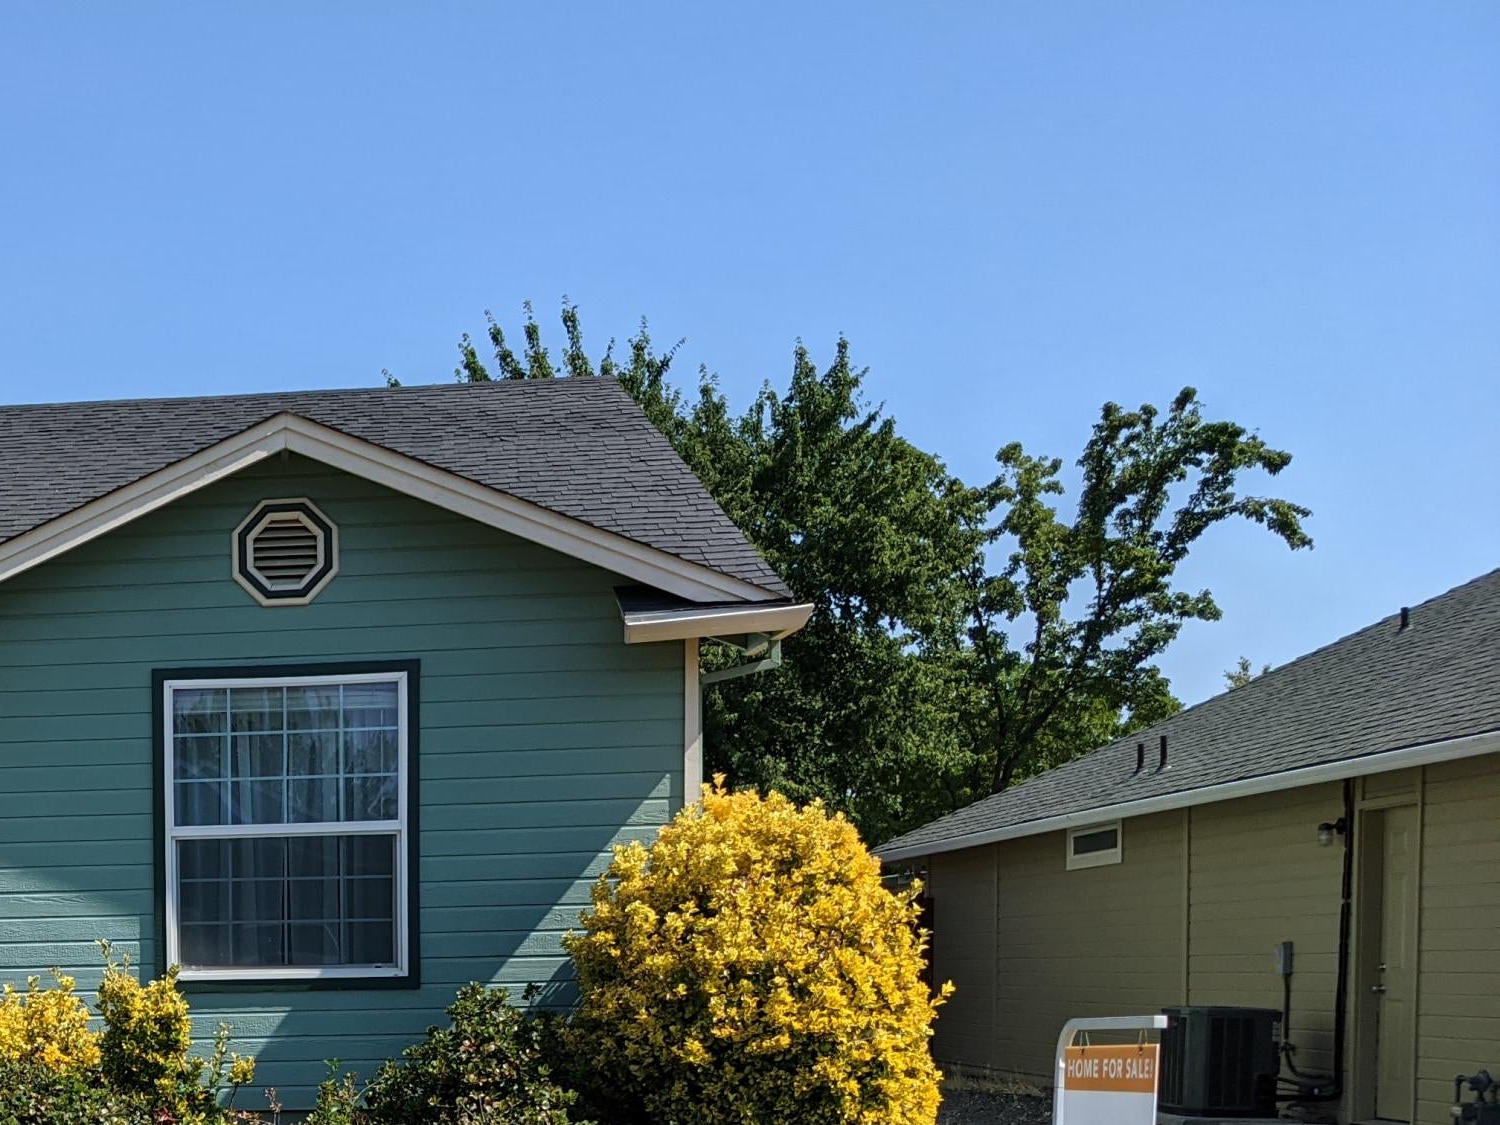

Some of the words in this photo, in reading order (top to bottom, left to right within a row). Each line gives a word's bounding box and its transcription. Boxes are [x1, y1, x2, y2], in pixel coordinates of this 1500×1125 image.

[1067, 1059, 1099, 1078] HOME
[1102, 1059, 1123, 1079] FOR
[1125, 1058, 1154, 1079] SALE!
